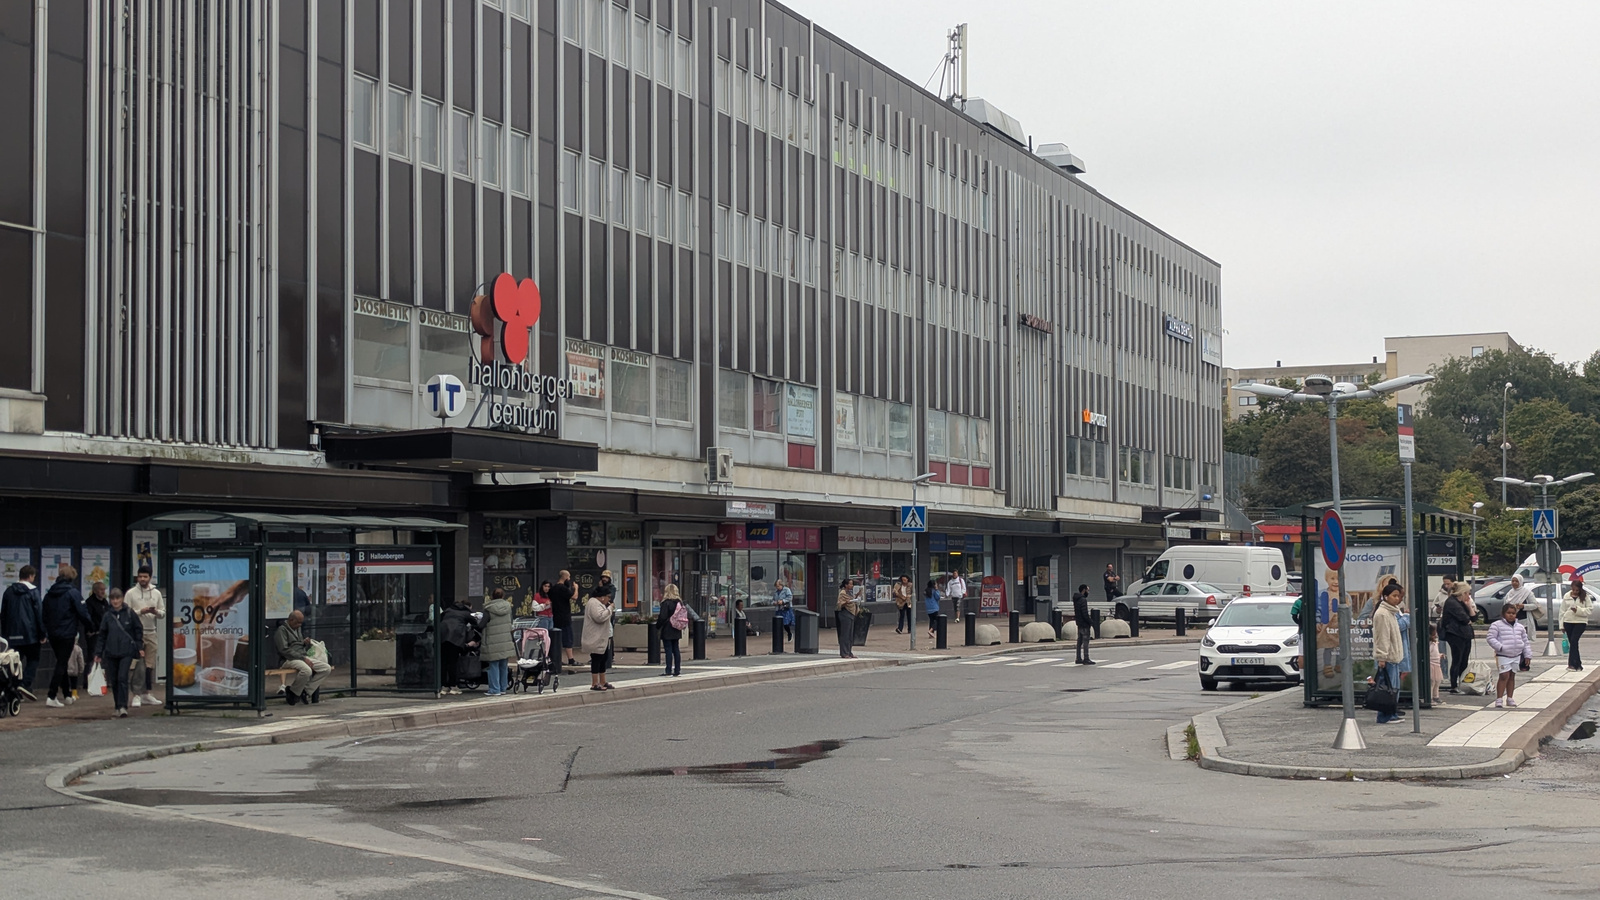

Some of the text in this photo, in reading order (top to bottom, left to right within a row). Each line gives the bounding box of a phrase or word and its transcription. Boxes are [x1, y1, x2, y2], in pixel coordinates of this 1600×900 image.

[360, 300, 409, 321] KOSMETIK
[427, 313, 470, 333] KOSMETI
[568, 340, 604, 358] KOSMETIK
[616, 350, 648, 367] KOSMETIK
[471, 355, 574, 403] hallonbergen
[428, 383, 440, 412] T
[446, 383, 461, 412] T
[492, 402, 556, 430] centrum
[749, 528, 769, 536] ATG
[358, 552, 365, 561] B
[1345, 552, 1384, 562] Nordea
[180, 605, 224, 624] 30%
[180, 626, 244, 636] på matförvaring
[1350, 627, 1370, 635] nsyn
